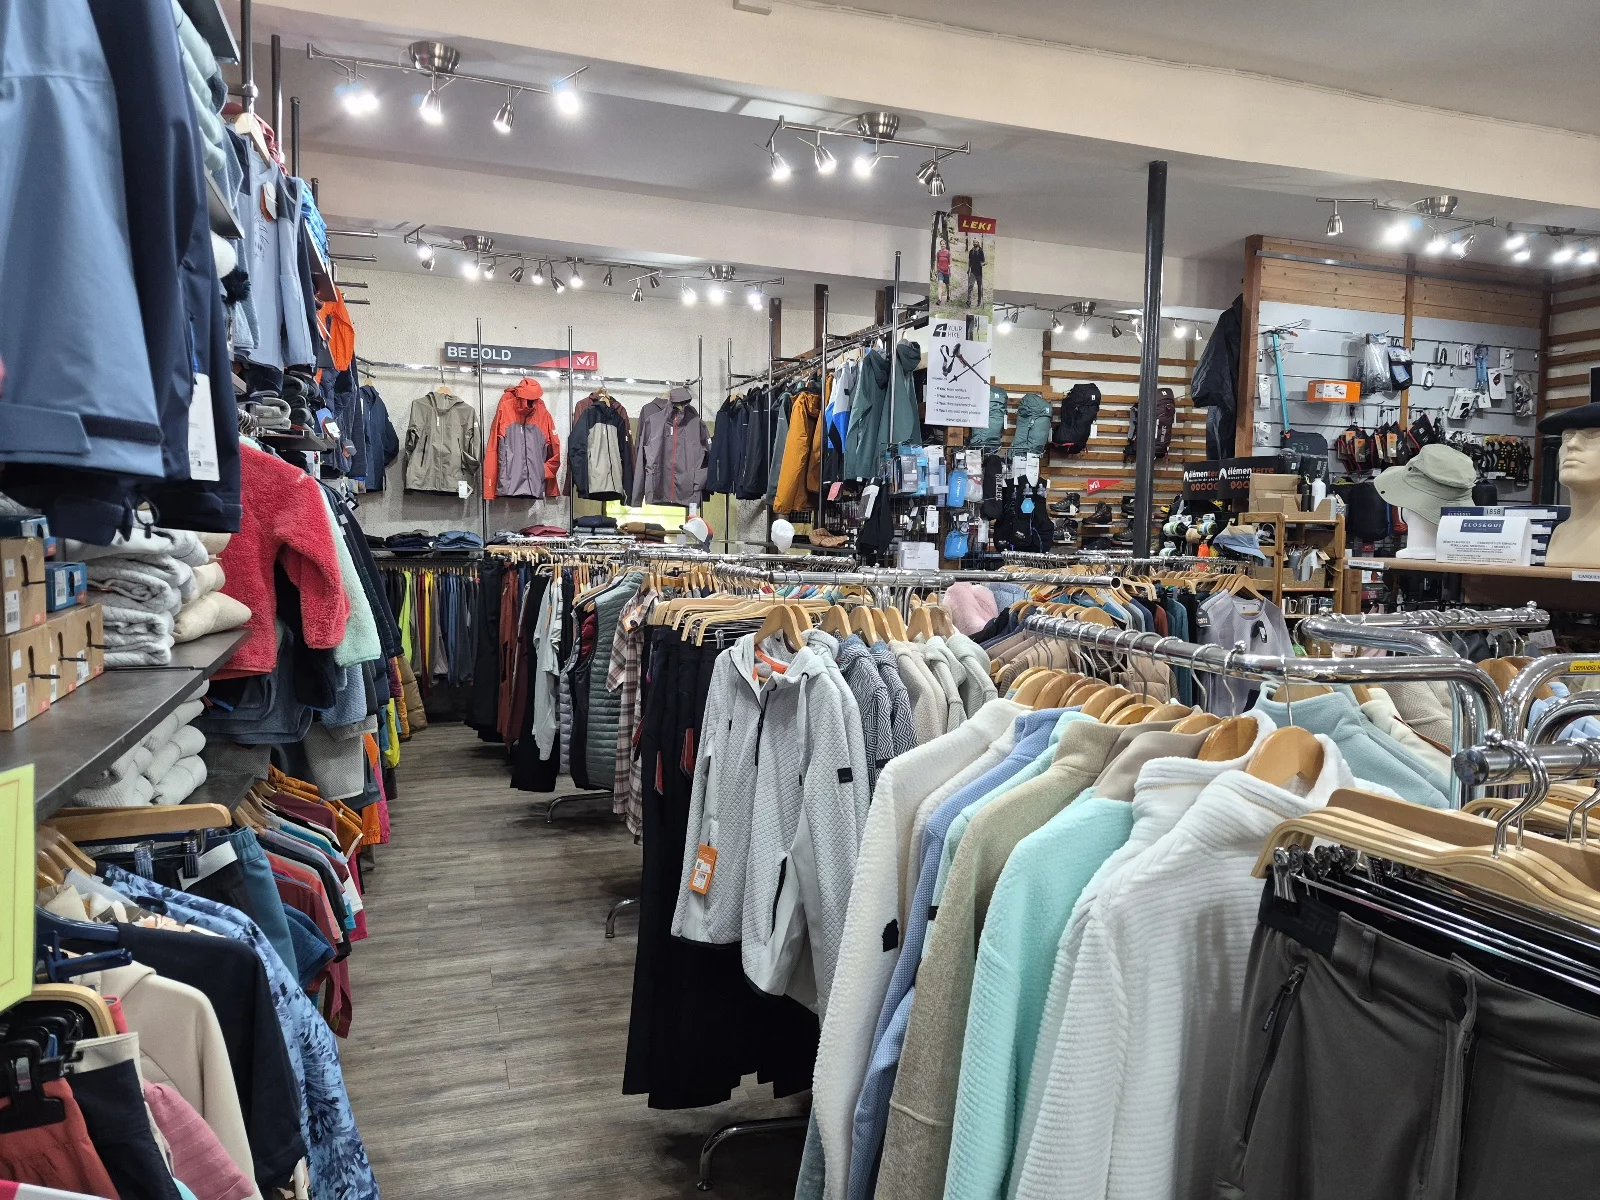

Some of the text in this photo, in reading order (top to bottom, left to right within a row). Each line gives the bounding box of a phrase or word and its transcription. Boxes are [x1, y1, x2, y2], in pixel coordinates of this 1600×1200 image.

[962, 219, 992, 231] LEKI
[447, 346, 512, 361] BE BOLD
